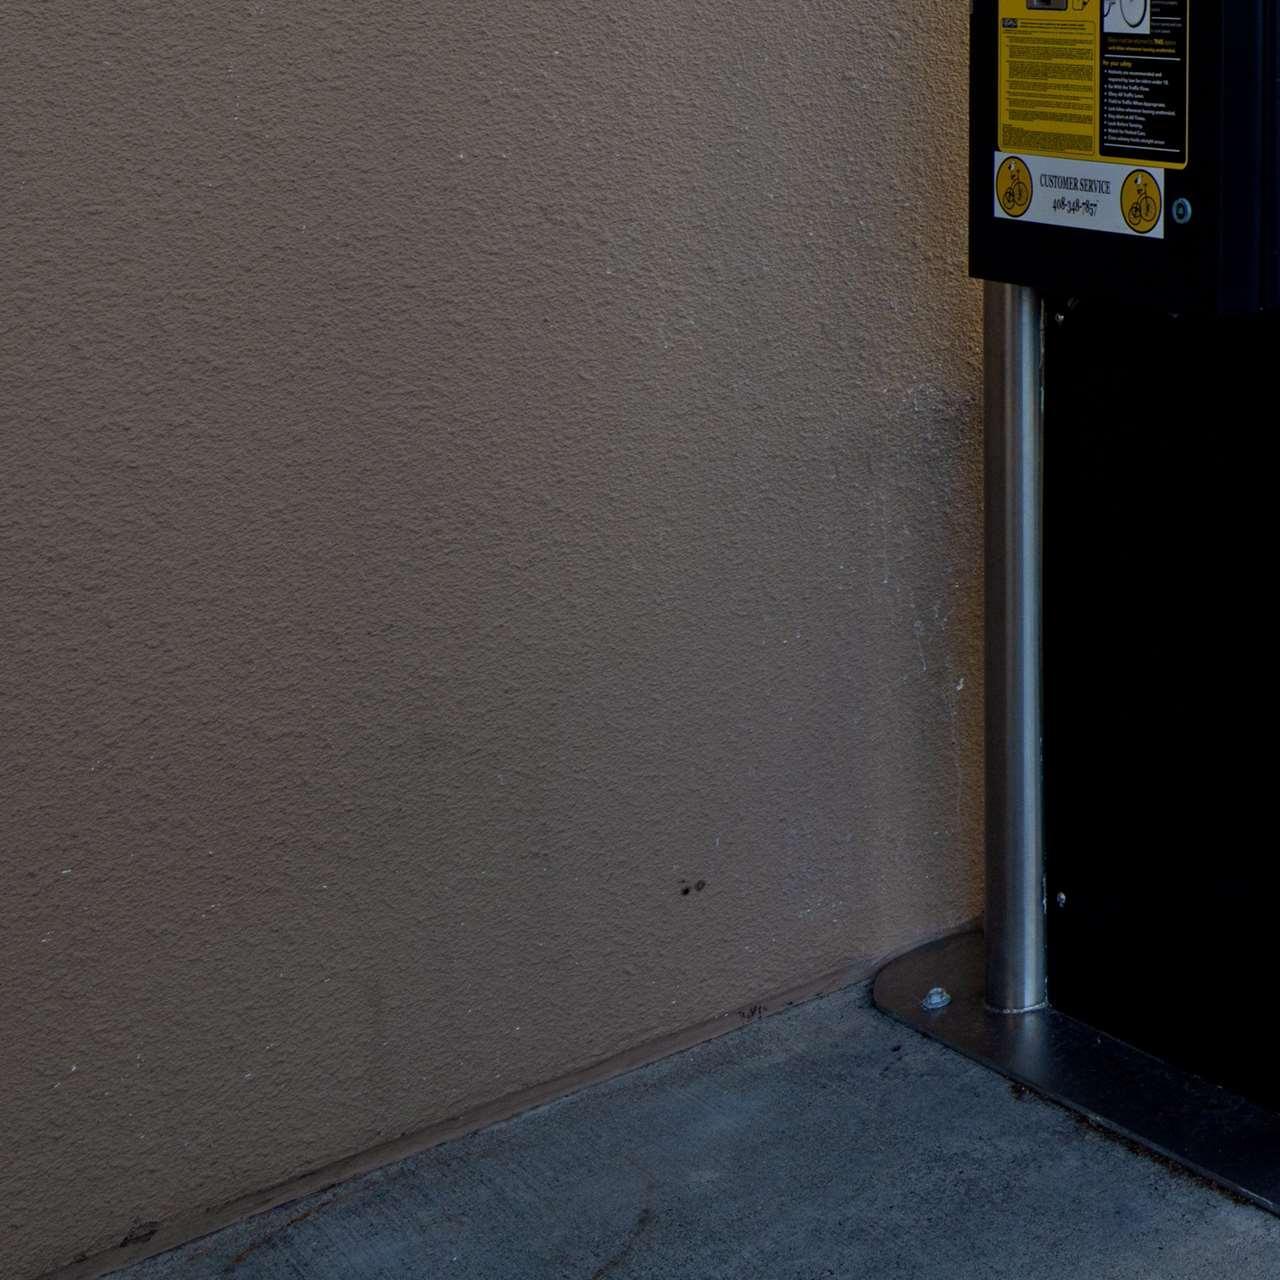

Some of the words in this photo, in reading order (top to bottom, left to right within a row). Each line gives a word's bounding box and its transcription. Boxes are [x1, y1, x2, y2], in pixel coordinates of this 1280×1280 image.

[1040, 173, 1078, 192] CUSTOMER
[1079, 177, 1111, 195] SERVICE
[1052, 197, 1097, 216] 408-348-7857
